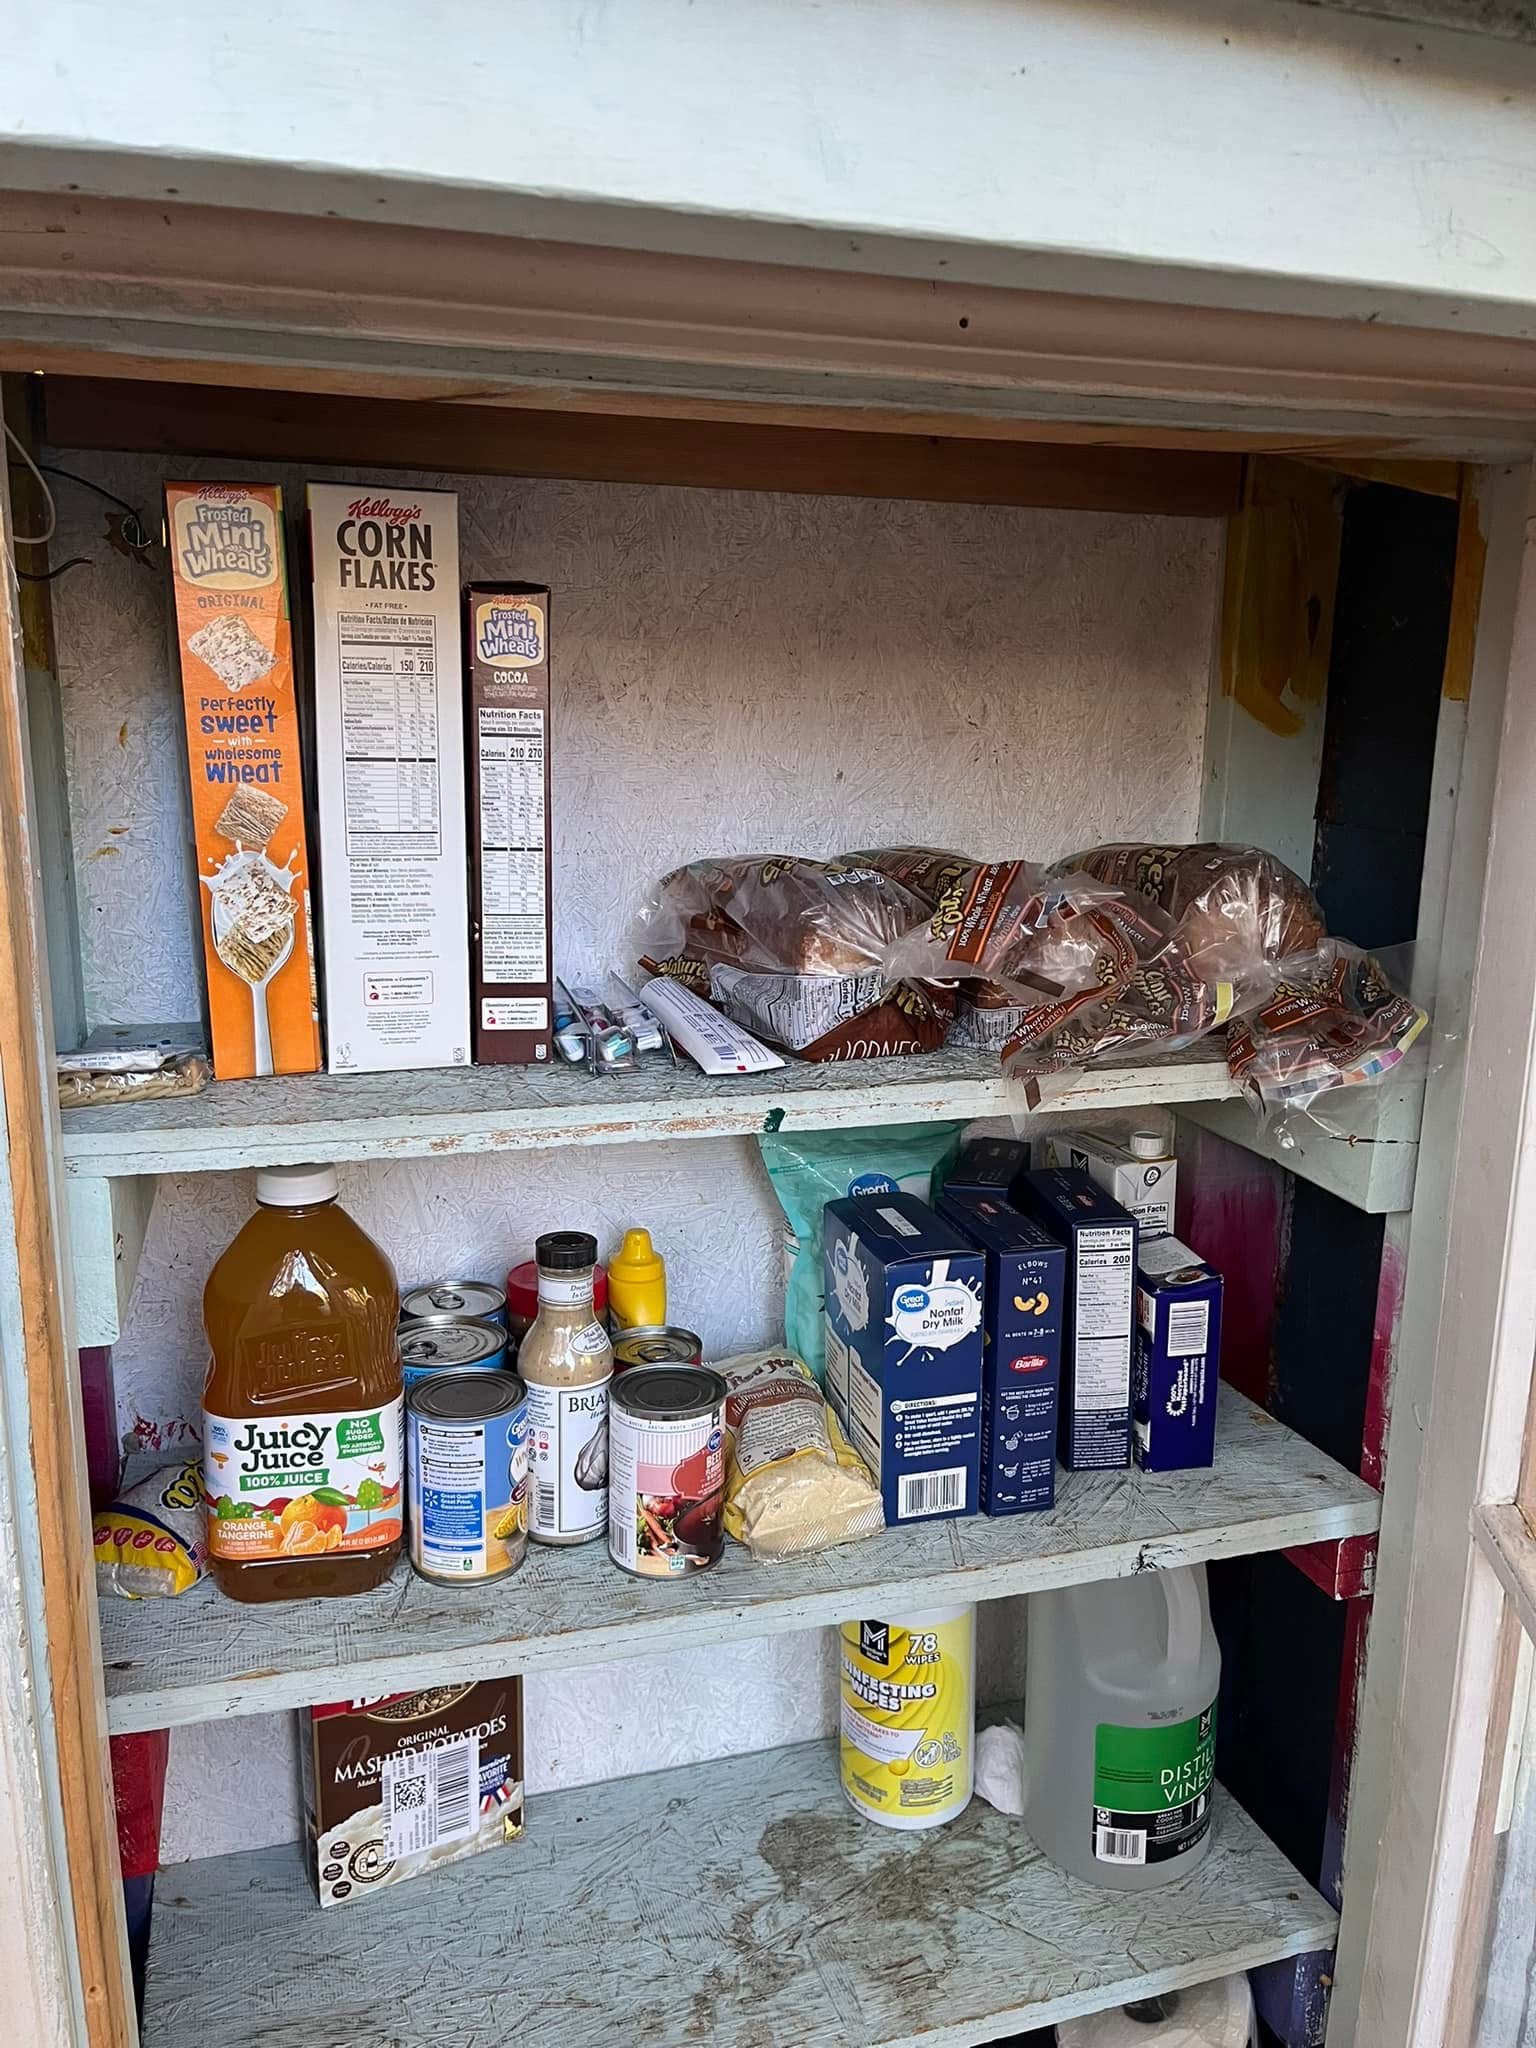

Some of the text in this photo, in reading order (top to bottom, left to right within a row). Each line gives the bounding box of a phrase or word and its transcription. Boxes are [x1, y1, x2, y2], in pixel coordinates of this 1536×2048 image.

[199, 508, 250, 524] Frosted
[348, 497, 422, 525] Kellogg's
[190, 521, 263, 551] Mini
[337, 520, 433, 560] CORN
[187, 548, 268, 575] Wheats
[339, 558, 436, 591] FLAKES
[197, 594, 265, 610] ORIGINAL
[492, 610, 527, 622] Frosted
[485, 619, 535, 641] Mini
[481, 637, 537, 658] Wheats
[400, 660, 414, 672] 150
[420, 660, 434, 672] 210
[493, 671, 529, 684] COCOA
[480, 709, 541, 720] Nutrition Facts
[200, 713, 278, 733] sweet
[228, 735, 253, 746] with
[205, 748, 281, 760] wholesome
[510, 747, 525, 758] 210
[528, 748, 543, 758] 270
[205, 761, 283, 783] wheat
[963, 907, 983, 928] Whole
[1276, 1004, 1299, 1017] 100%
[1302, 1003, 1321, 1015] with
[1014, 1013, 1046, 1038] Whole
[1019, 1004, 1067, 1046] with Honey
[1147, 1205, 1166, 1214] Facts
[1079, 1228, 1131, 1238] Nutrition Facts
[1017, 1260, 1049, 1271] ELBOWS
[1079, 1255, 1131, 1266] Calories 200
[900, 1294, 924, 1303] Great
[930, 1307, 964, 1319] Nonfat
[922, 1316, 963, 1329] Dry Milk
[1014, 1358, 1046, 1369] Barilla
[905, 1400, 936, 1408] DIRECTIONS
[350, 1419, 370, 1429] NO
[234, 1422, 332, 1452] Juicy
[346, 1427, 373, 1435] SUGAR
[241, 1449, 324, 1473] Juice
[246, 1472, 324, 1488] 100% JUICE
[222, 1520, 267, 1531] ORANGE
[217, 1529, 275, 1541] TANGERINE
[909, 1633, 938, 1655] 78
[905, 1652, 940, 1665] WIPES
[851, 1677, 901, 1711] WIPES
[397, 1725, 450, 1748] ORIGINAL
[356, 1776, 378, 1789] Made
